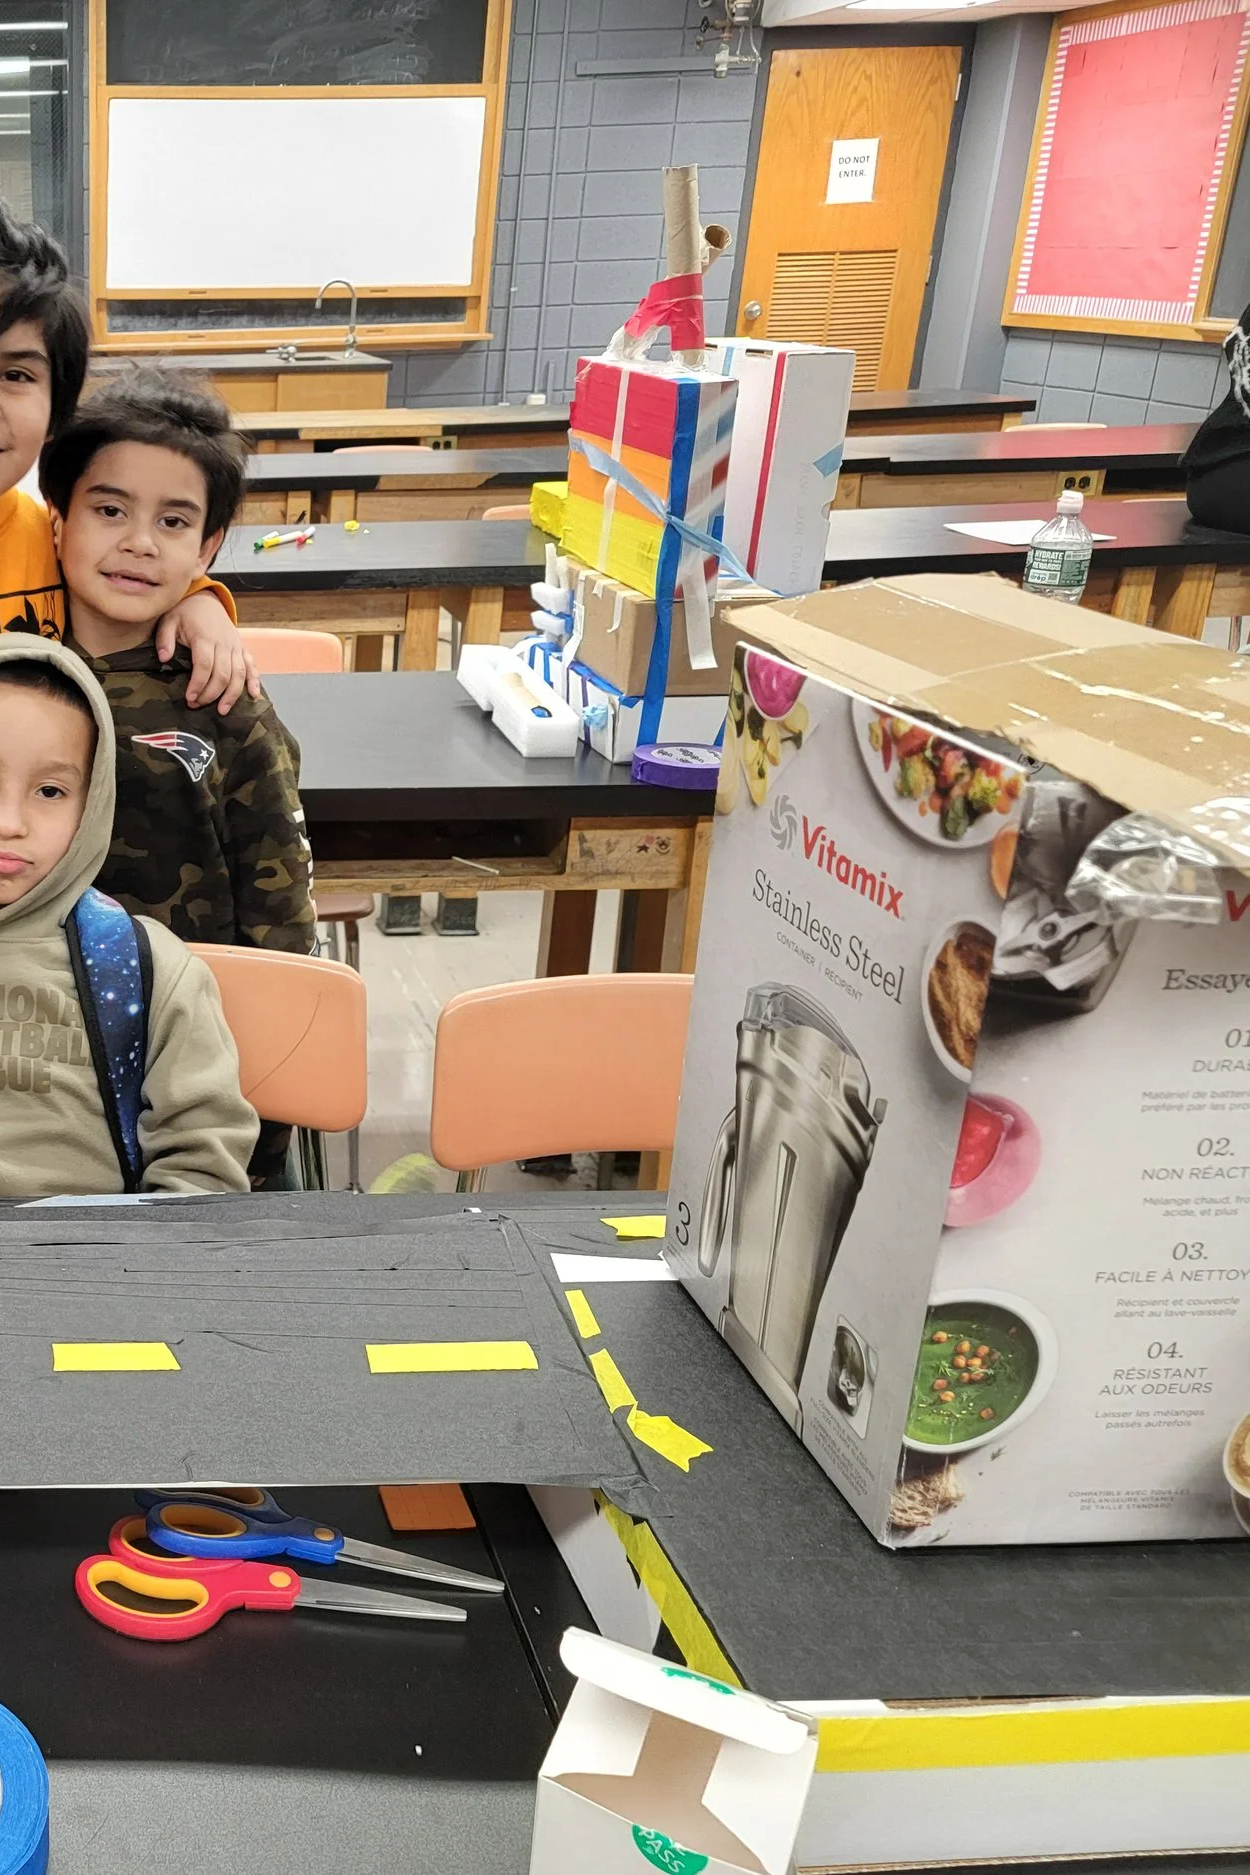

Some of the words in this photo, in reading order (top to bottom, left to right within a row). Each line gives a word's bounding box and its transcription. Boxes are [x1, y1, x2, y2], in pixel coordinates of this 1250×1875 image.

[838, 156, 851, 165] DO
[852, 155, 870, 164] NOT
[838, 169, 866, 178] ENTER.
[1034, 550, 1064, 560] HYDRATE
[802, 814, 903, 919] Vitamix
[752, 868, 842, 958] Stainless
[846, 935, 905, 1005] Steel
[776, 931, 815, 967] CONTAINER
[1196, 1137, 1235, 1157] 02.
[1141, 1168, 1184, 1181] NON
[1189, 1164, 1250, 1180] RÉACT
[1215, 1206, 1238, 1218] plus
[1172, 1241, 1208, 1261] 03.
[1094, 1270, 1157, 1284] FACILE
[1161, 1267, 1174, 1282] À
[1172, 1298, 1183, 1307] et
[1148, 1310, 1161, 1318] au
[1147, 1341, 1184, 1359] 04.
[1113, 1366, 1208, 1381] RÉSISTANT
[1098, 1383, 1137, 1396] AUX
[1142, 1382, 1213, 1395] ODEURS
[1095, 1409, 1132, 1419] Laisser
[1136, 1409, 1150, 1418] les
[1153, 1408, 1205, 1419] mélanges
[1105, 1419, 1142, 1430] passés
[1144, 1418, 1192, 1428] autrefois
